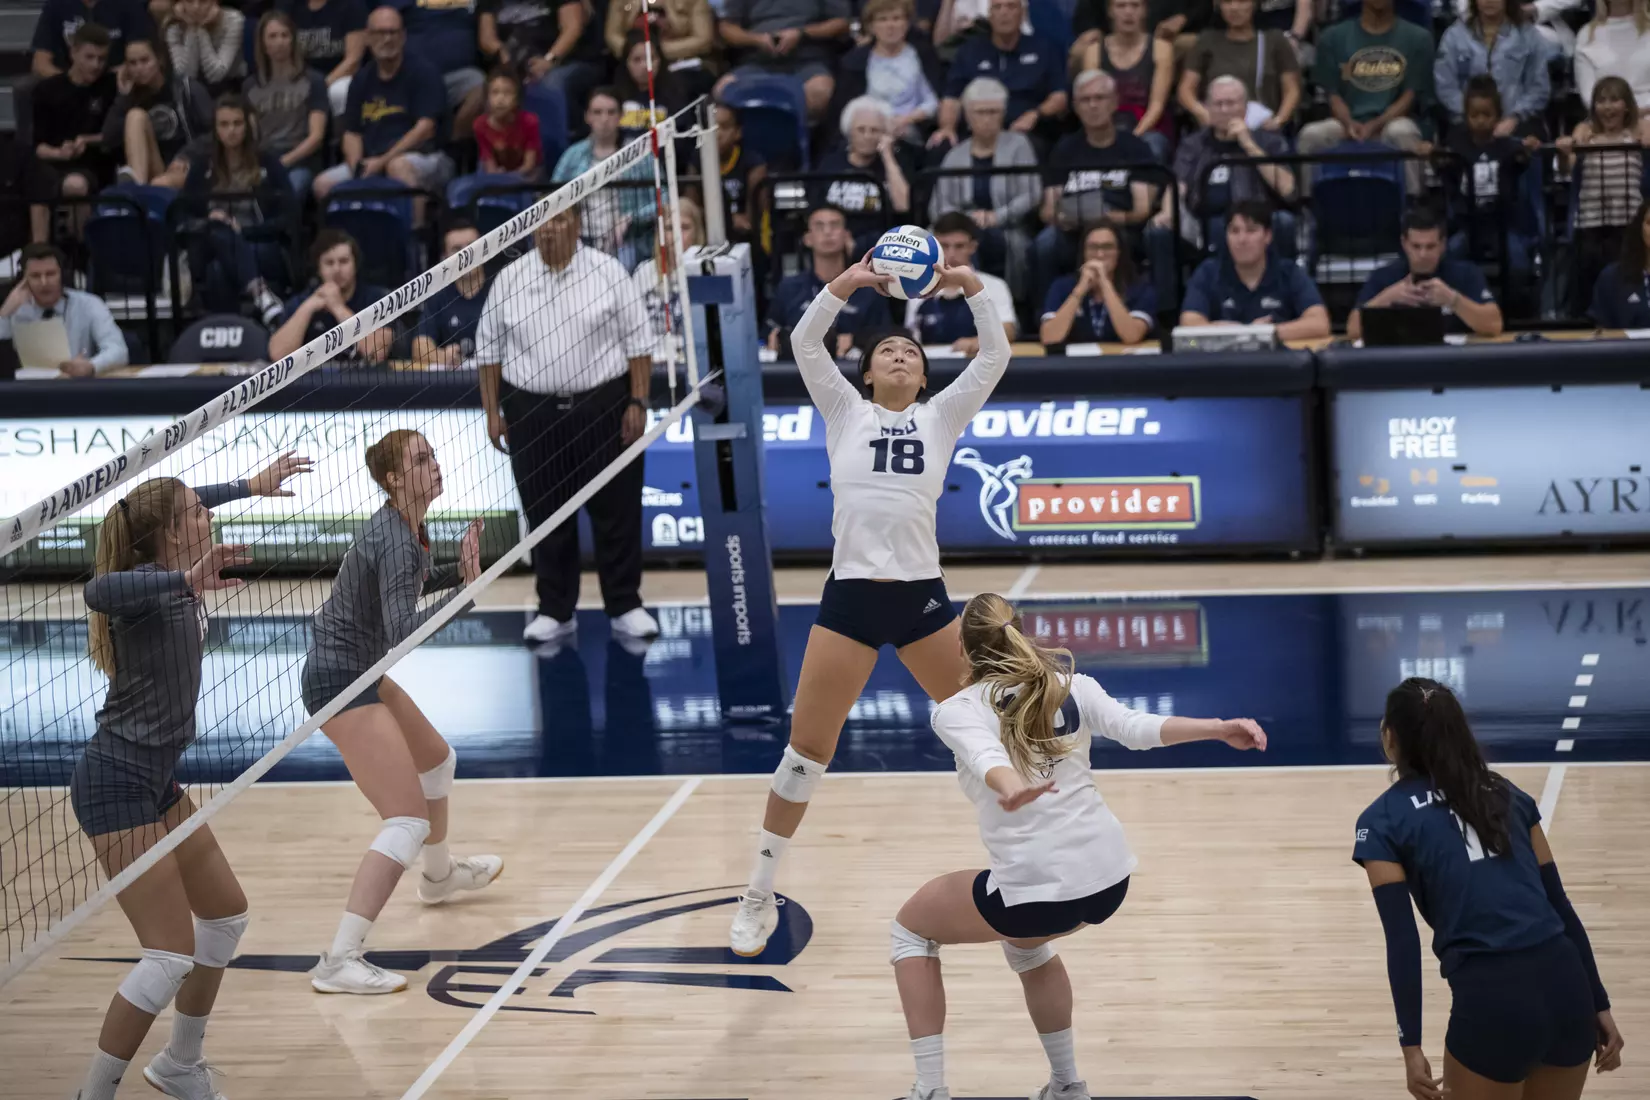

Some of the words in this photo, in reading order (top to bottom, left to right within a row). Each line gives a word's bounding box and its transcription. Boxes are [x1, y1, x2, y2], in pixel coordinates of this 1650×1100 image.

[881, 245, 914, 261] NCAA
[882, 234, 921, 248] molten
[200, 327, 243, 348] CBU
[39, 455, 128, 527] #LANCEUP
[164, 419, 187, 451] CBU
[221, 356, 294, 418] #LANCEUP
[325, 326, 344, 354] CBU
[372, 272, 433, 326] #LANCEUP
[458, 247, 474, 272] CBU
[958, 401, 1161, 438] ovider.
[1388, 417, 1457, 435] ENJOY
[869, 438, 925, 475] 18
[1389, 434, 1458, 459] FREE
[1028, 489, 1180, 521] provider
[1537, 476, 1650, 516] AYR
[1029, 534, 1088, 545] contract
[1092, 532, 1125, 544] food
[1129, 531, 1178, 543] service
[725, 535, 746, 584] sports
[732, 585, 752, 645] imports
